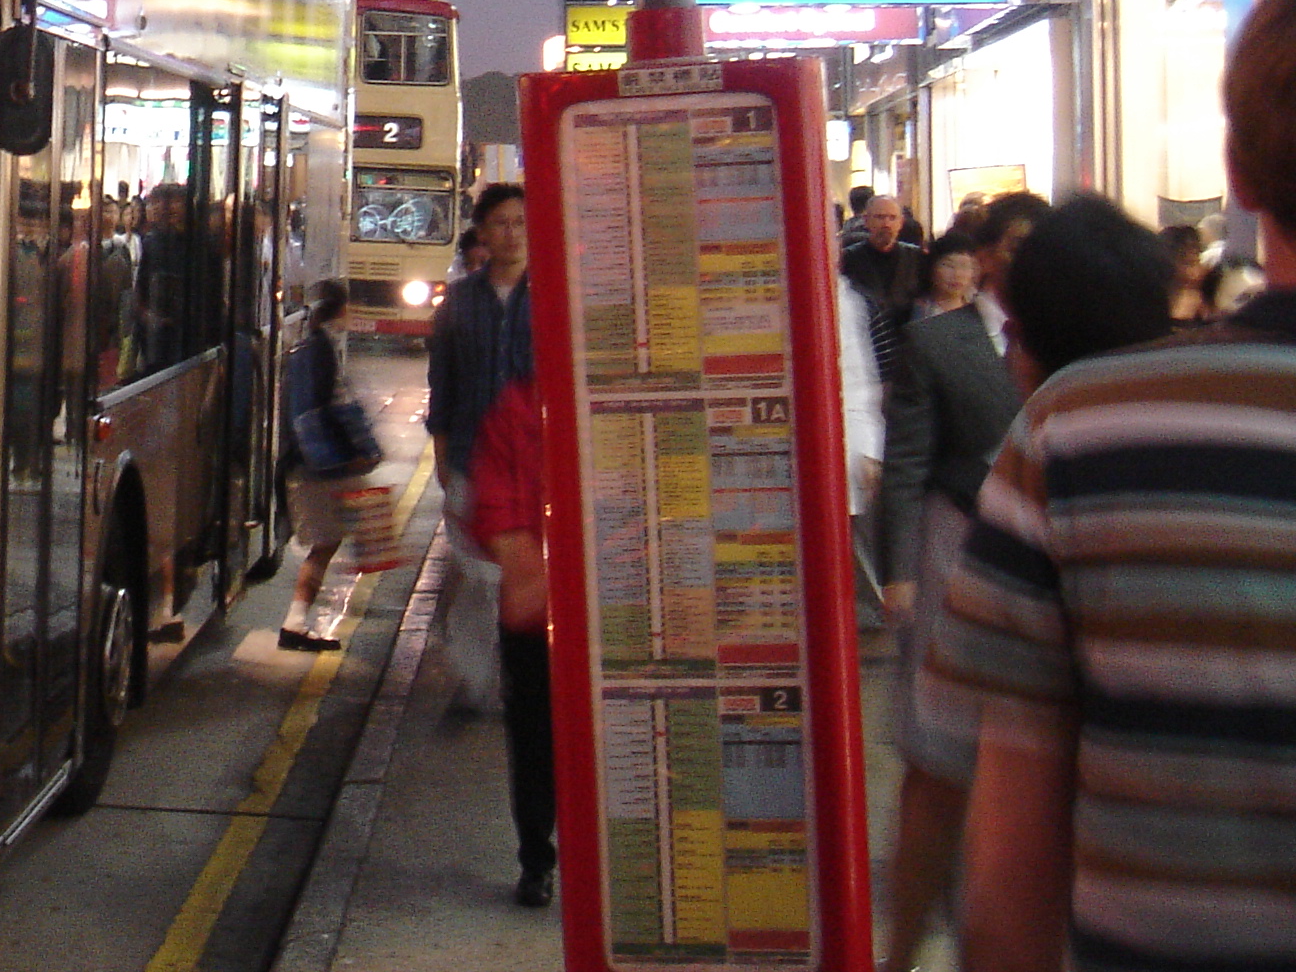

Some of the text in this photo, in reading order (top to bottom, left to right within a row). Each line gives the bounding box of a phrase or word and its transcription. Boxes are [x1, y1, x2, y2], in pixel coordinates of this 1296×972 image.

[382, 121, 400, 143] 2
[756, 401, 787, 421] 1A
[772, 689, 788, 710] 2
